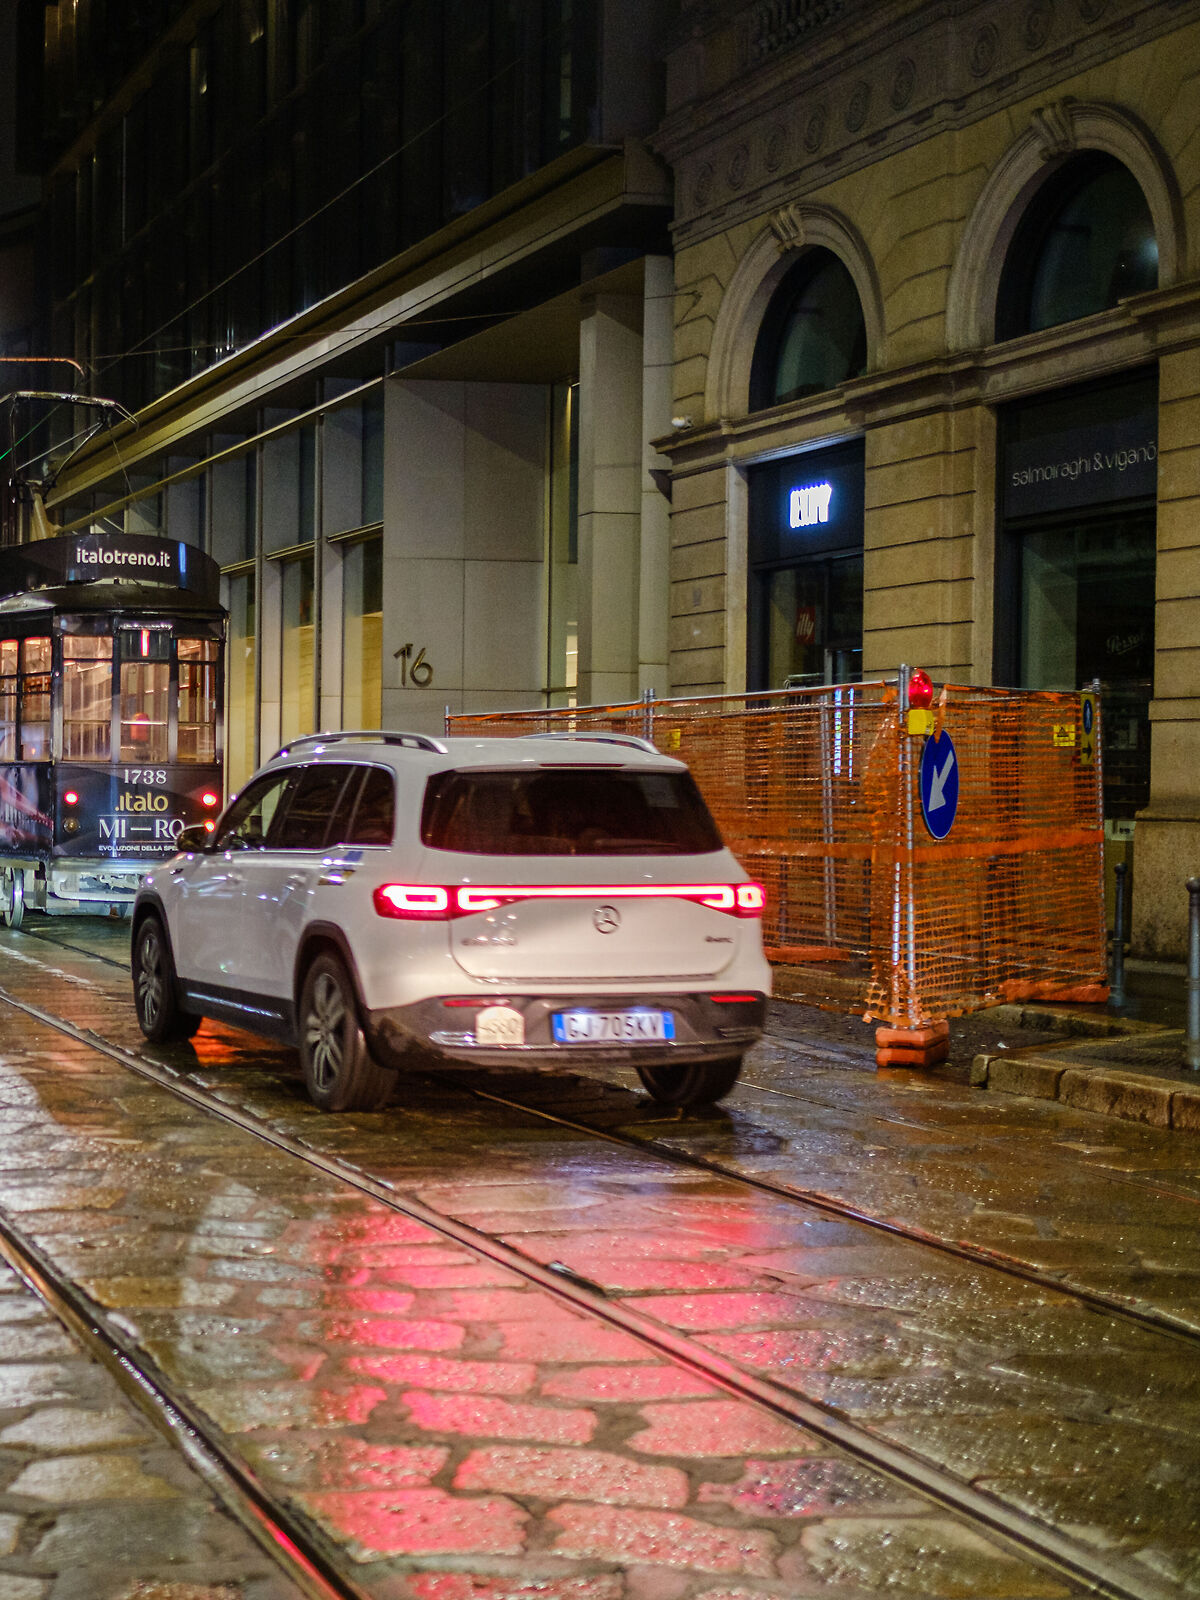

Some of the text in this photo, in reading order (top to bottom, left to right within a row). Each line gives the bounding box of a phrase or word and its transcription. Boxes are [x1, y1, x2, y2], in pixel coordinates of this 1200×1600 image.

[1093, 452, 1104, 471] &
[76, 547, 171, 568] italotreno.it
[393, 643, 433, 687] 16
[124, 769, 167, 784] 1738
